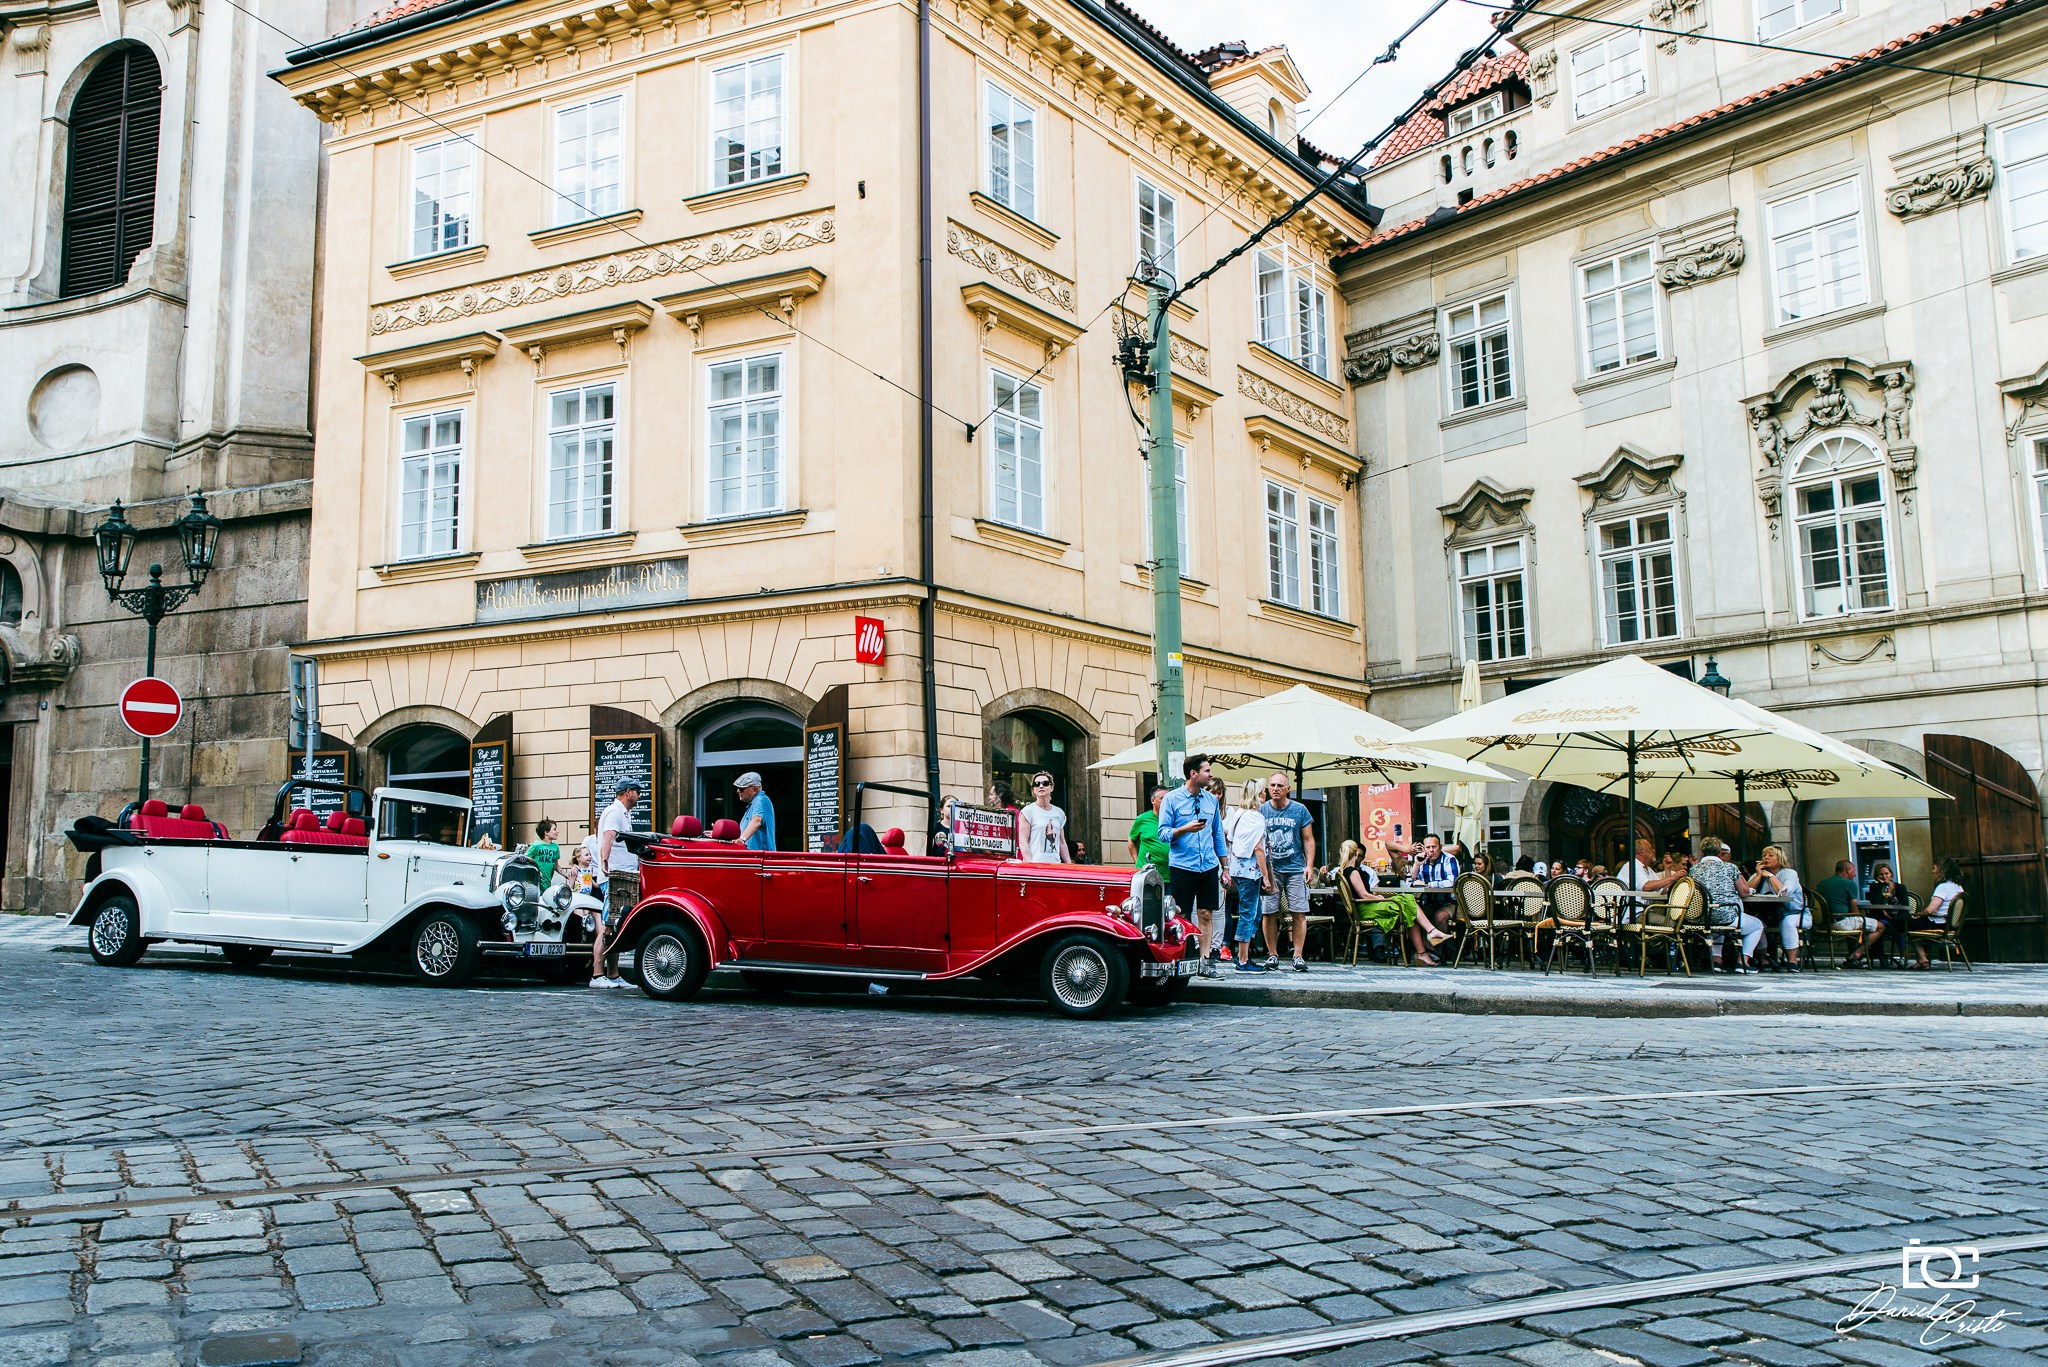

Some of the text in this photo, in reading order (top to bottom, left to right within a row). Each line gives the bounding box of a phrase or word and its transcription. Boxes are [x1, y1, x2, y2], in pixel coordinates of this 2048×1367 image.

[858, 623, 884, 661] illy
[1375, 810, 1385, 825] 3
[1367, 827, 1376, 838] 2
[1856, 823, 1889, 836] ATM
[970, 838, 981, 846] OLD
[982, 838, 1003, 849] PRAGUE
[531, 944, 543, 955] 3AV
